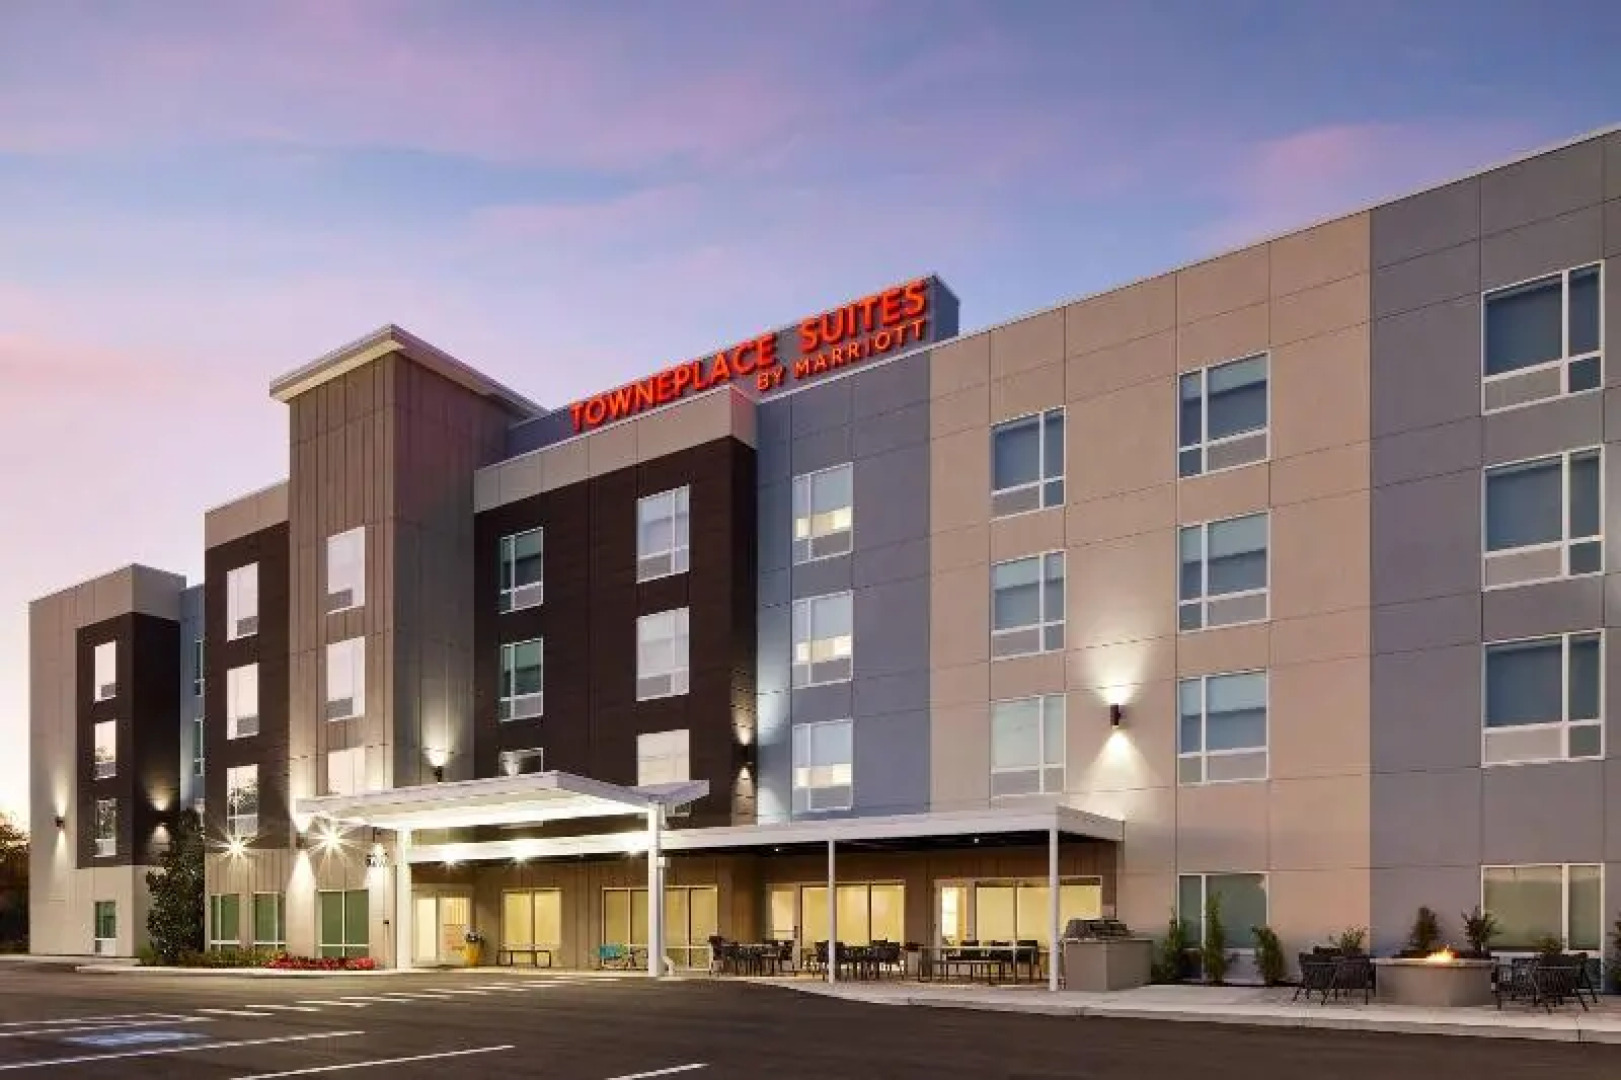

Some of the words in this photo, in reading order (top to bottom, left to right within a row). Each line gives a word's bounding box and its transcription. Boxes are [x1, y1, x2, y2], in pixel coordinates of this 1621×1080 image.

[570, 333, 778, 432] TOWNEPLACE
[796, 279, 926, 354] SUITES
[756, 366, 786, 392] BY
[793, 318, 926, 380] MARRIOTT
